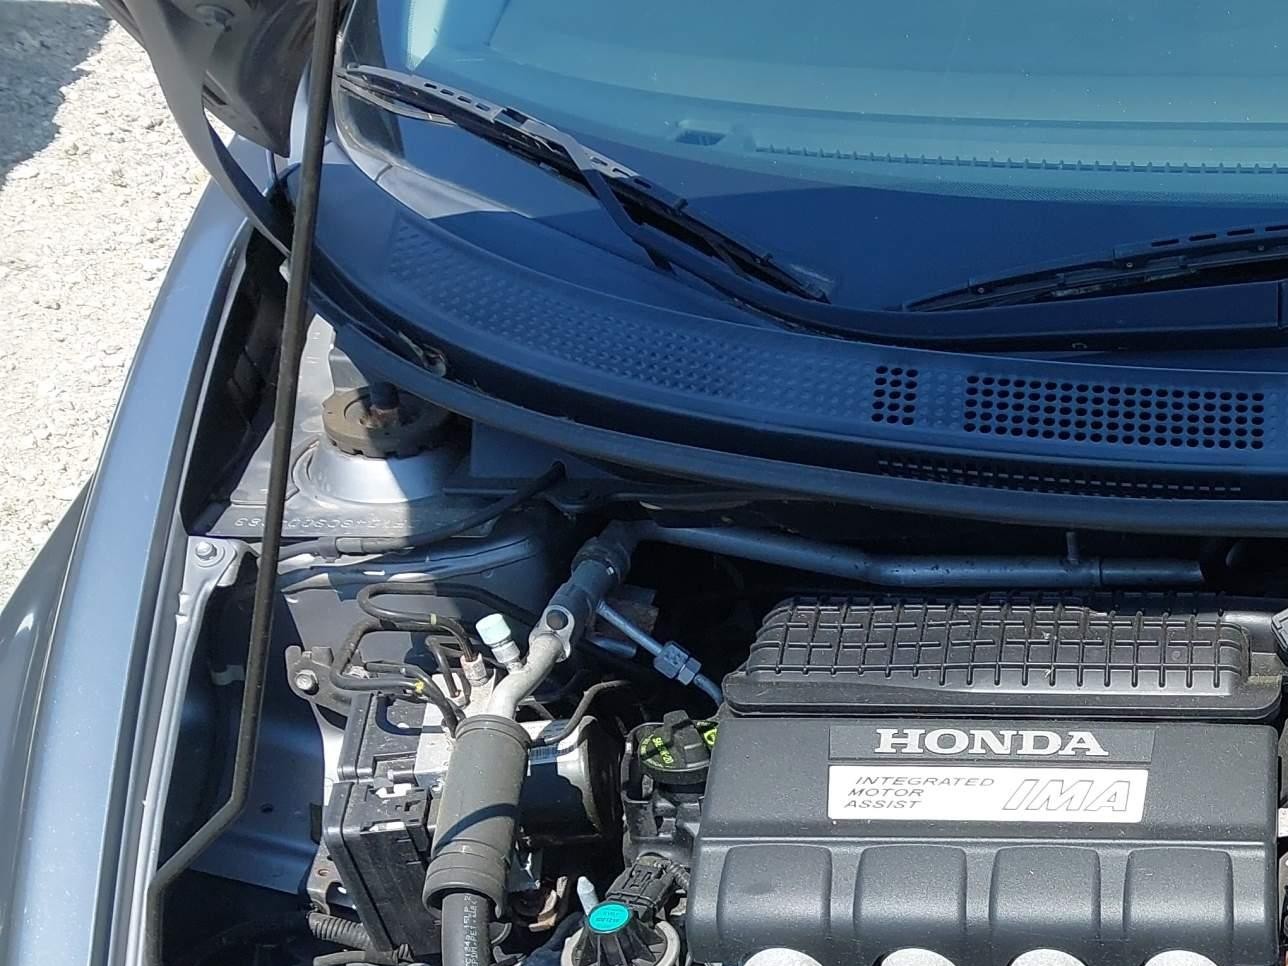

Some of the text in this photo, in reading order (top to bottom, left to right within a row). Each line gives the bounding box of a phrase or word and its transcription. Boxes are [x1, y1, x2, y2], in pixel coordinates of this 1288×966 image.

[873, 728, 1110, 757] HONDA
[855, 776, 995, 788] INTEGRATED
[847, 788, 925, 798] MOTOR
[1002, 778, 1132, 813] IMA
[843, 800, 923, 810] ASSIST
